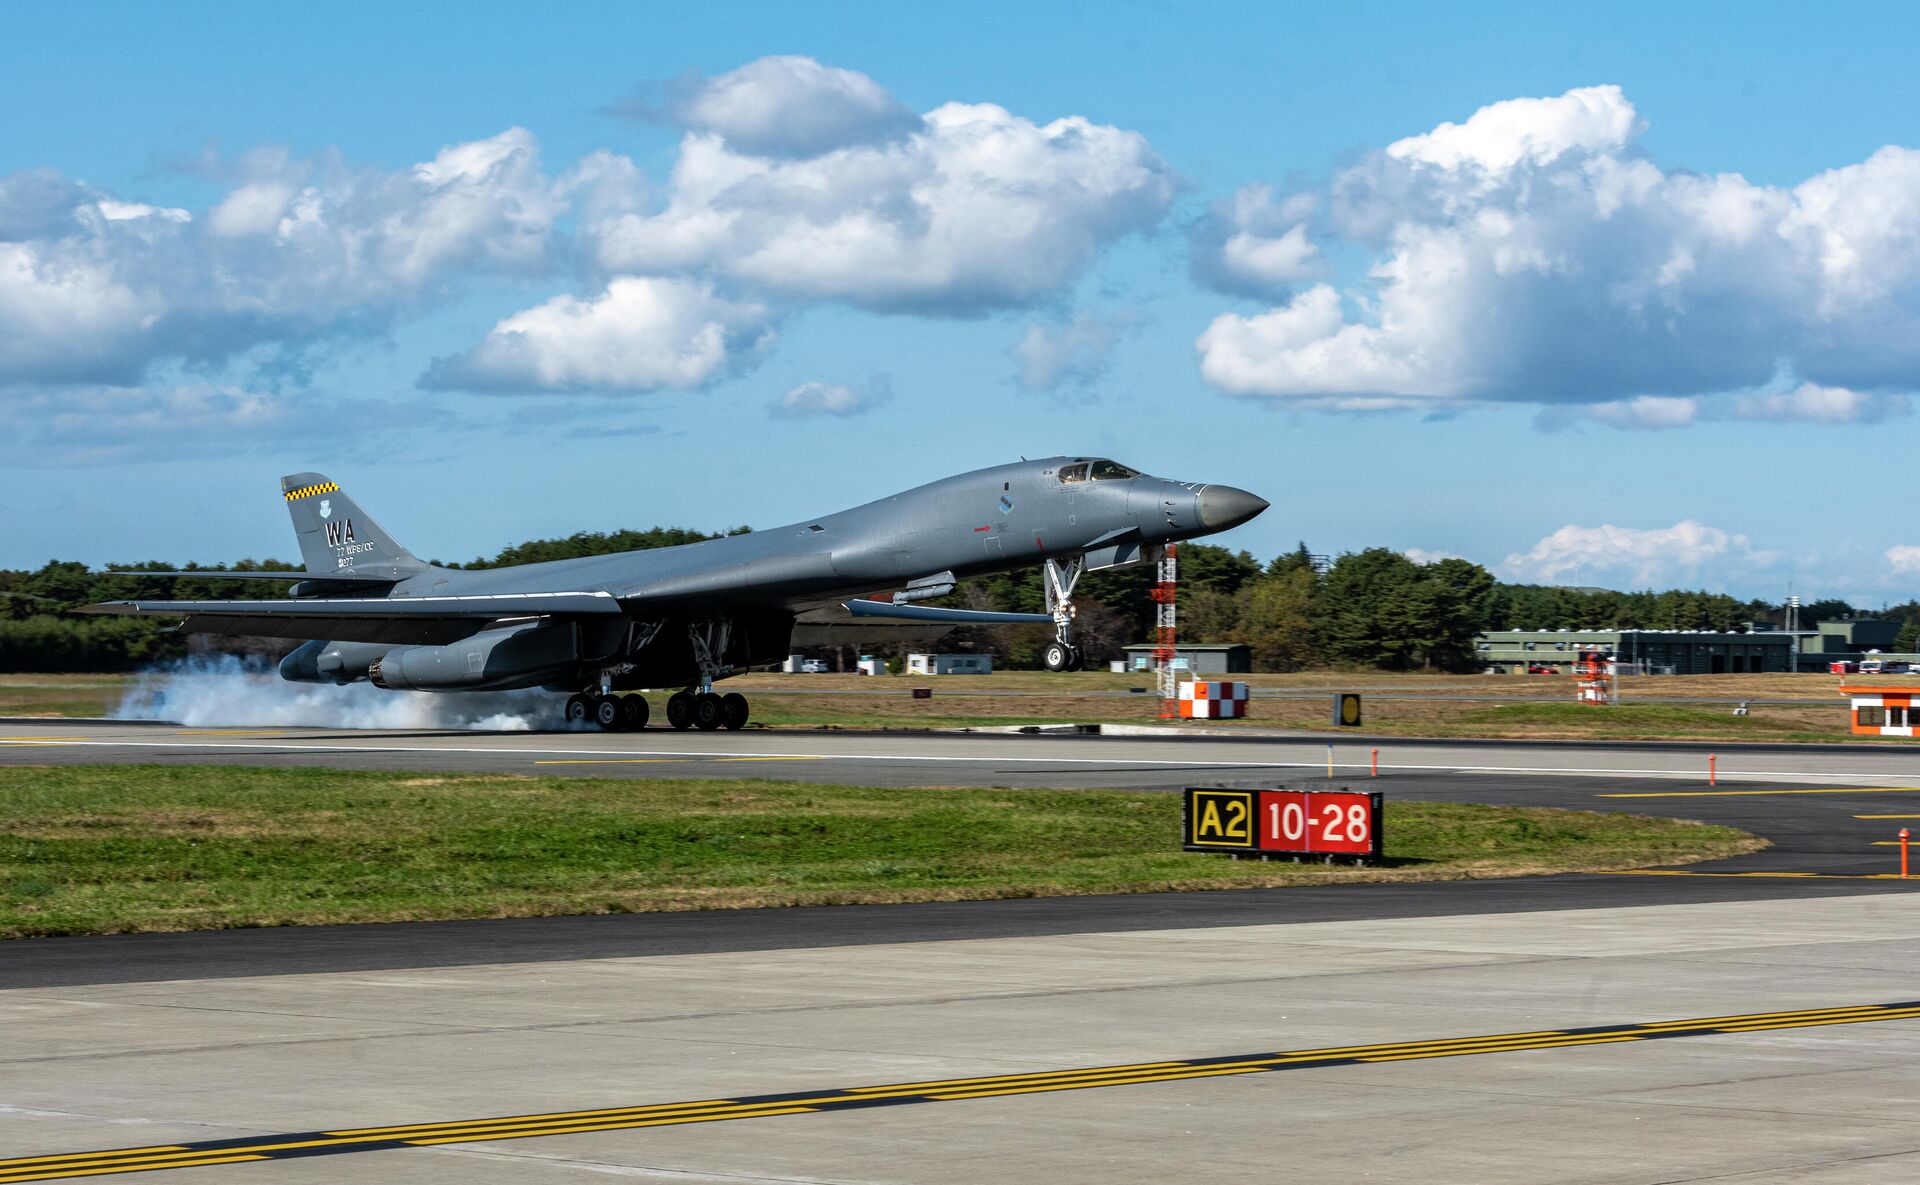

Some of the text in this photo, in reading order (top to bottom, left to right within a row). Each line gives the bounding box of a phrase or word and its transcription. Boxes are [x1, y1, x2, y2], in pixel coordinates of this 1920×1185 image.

[325, 518, 355, 547] WA
[1199, 800, 1247, 837] A2
[1269, 802, 1367, 842] 10-28
